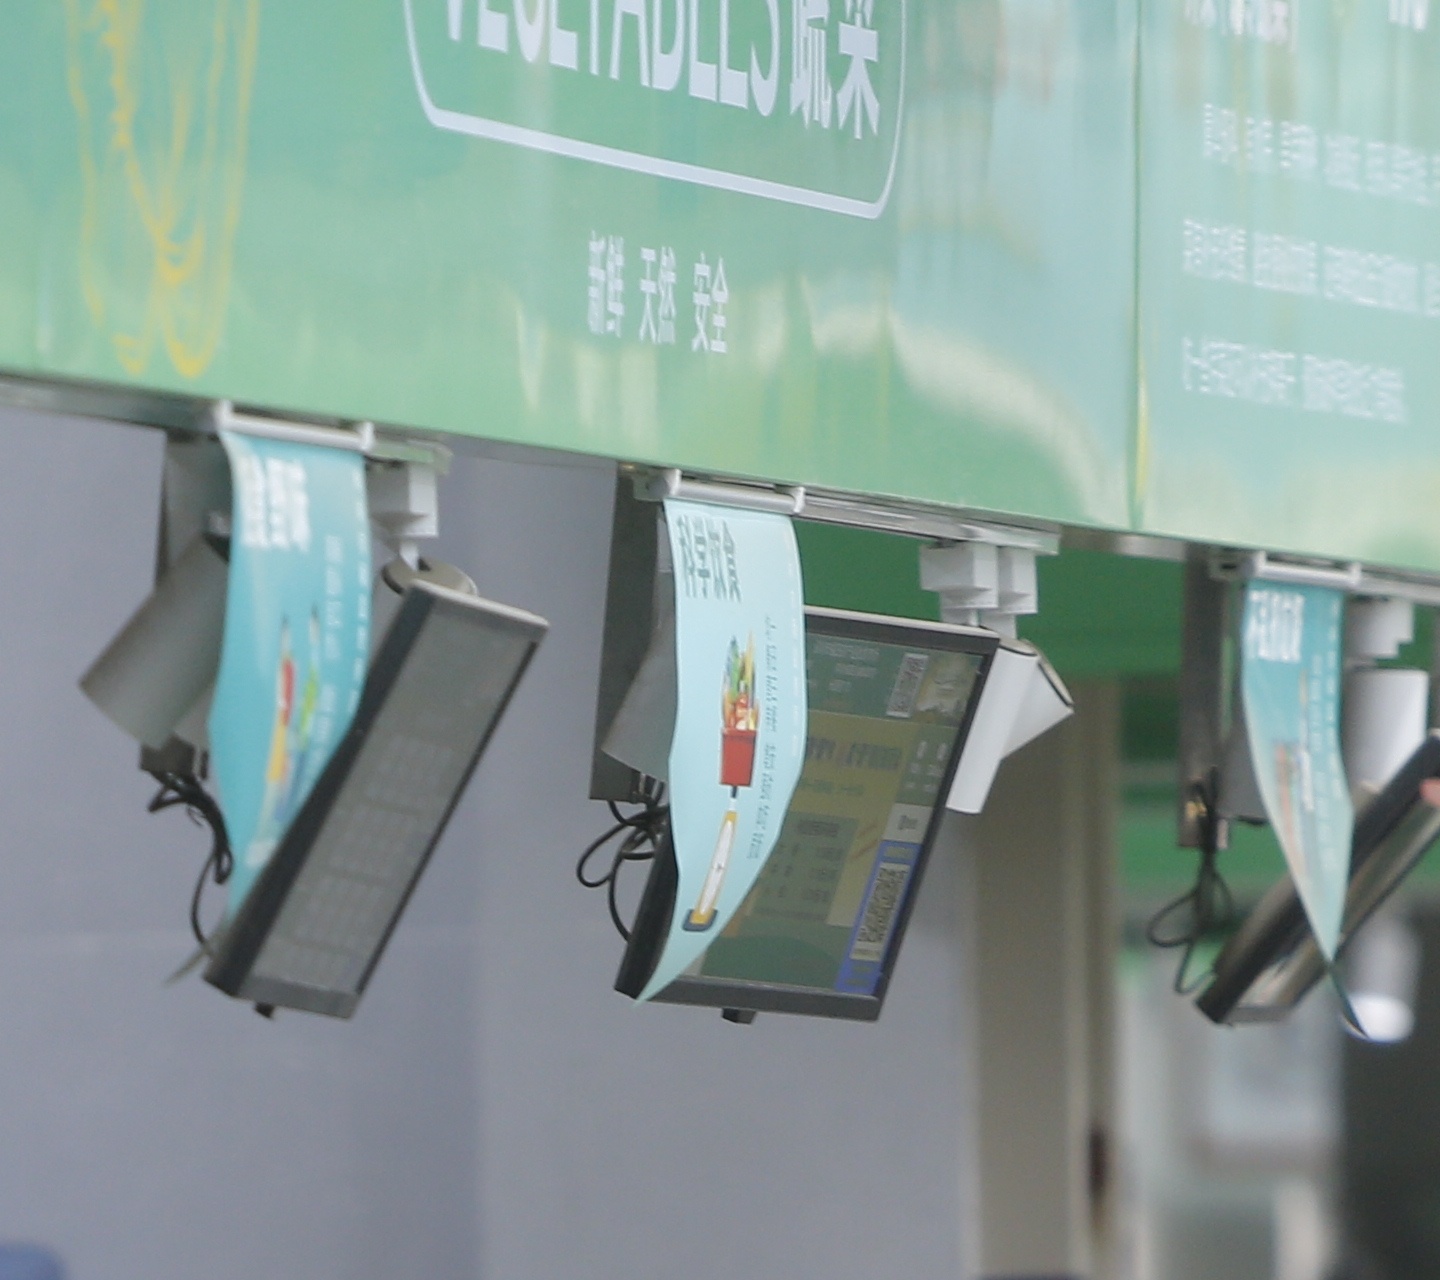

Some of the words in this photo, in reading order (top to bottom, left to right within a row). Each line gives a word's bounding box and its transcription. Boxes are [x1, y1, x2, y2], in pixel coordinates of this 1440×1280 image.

[587, 229, 625, 338] 新鲜
[639, 246, 677, 345] 天然
[691, 250, 729, 353] 安全
